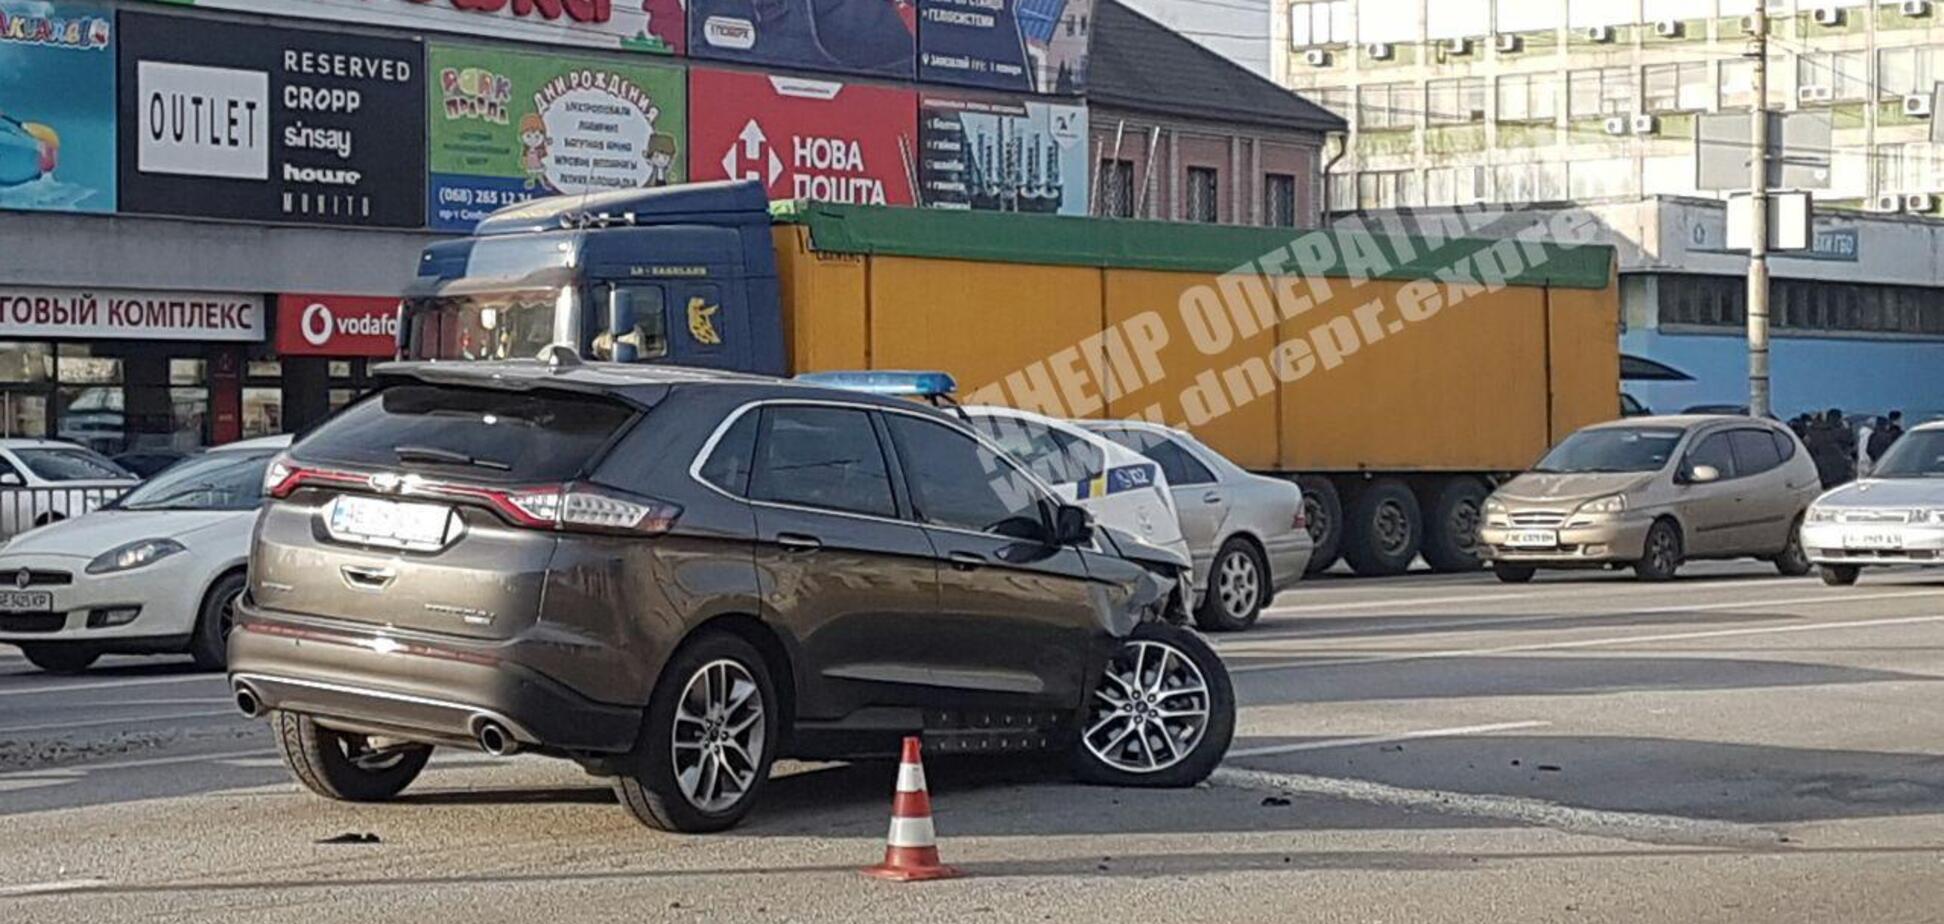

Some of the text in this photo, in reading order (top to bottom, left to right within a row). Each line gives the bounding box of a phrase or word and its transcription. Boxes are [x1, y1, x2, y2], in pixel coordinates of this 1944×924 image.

[284, 50, 411, 81] RESERVED
[284, 85, 361, 112] CROPP
[533, 69, 660, 122] ДНИ РОЖДЕНИЯ
[150, 92, 257, 149] OUTLET
[284, 121, 351, 158] sinsay
[792, 134, 865, 172] НОВА
[792, 173, 888, 206] ПОШТА
[107, 298, 253, 330] КОМПЛЕКС
